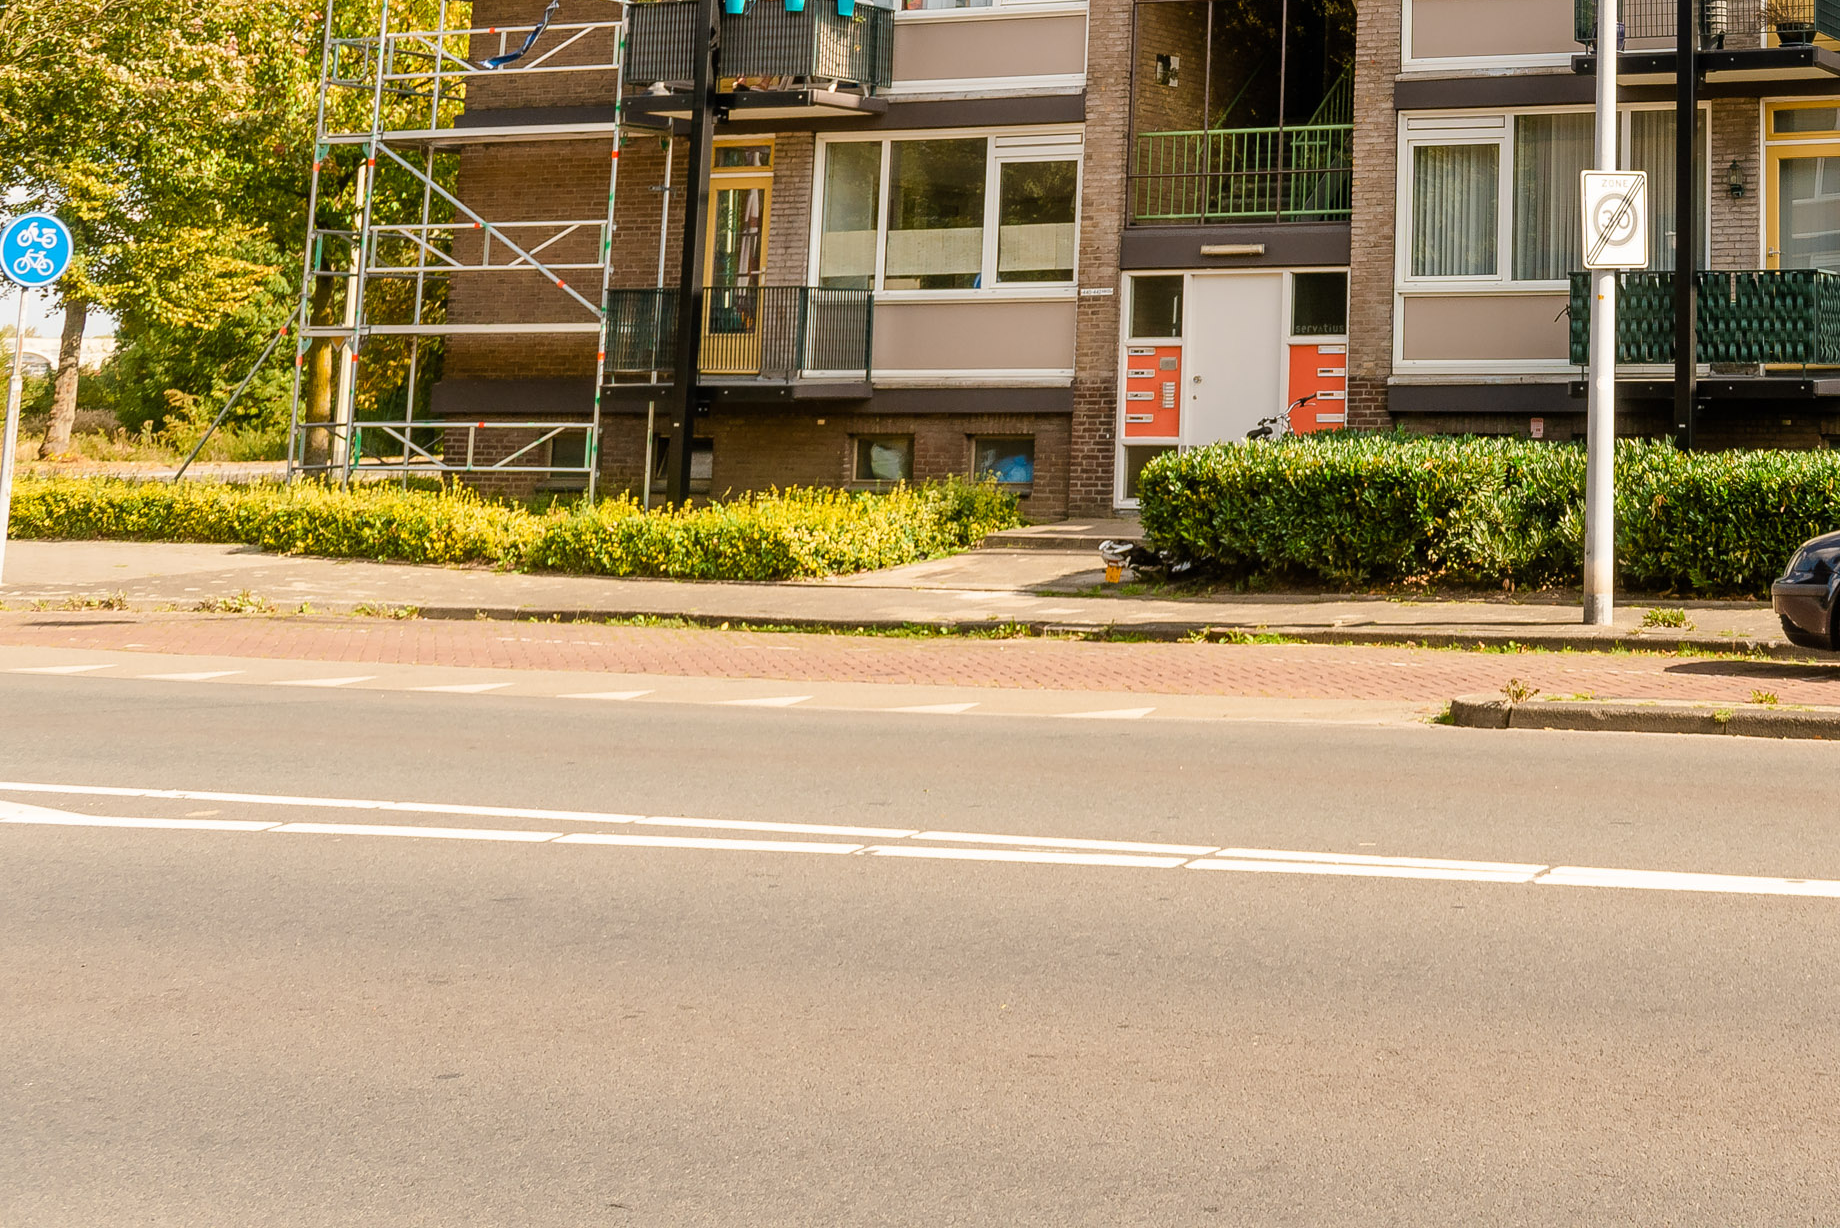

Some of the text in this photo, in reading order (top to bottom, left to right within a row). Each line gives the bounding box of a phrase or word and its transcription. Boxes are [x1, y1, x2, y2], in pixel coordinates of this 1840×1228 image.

[1601, 179, 1629, 188] ZONE
[1602, 210, 1631, 230] 30
[1295, 323, 1345, 333] servatius
